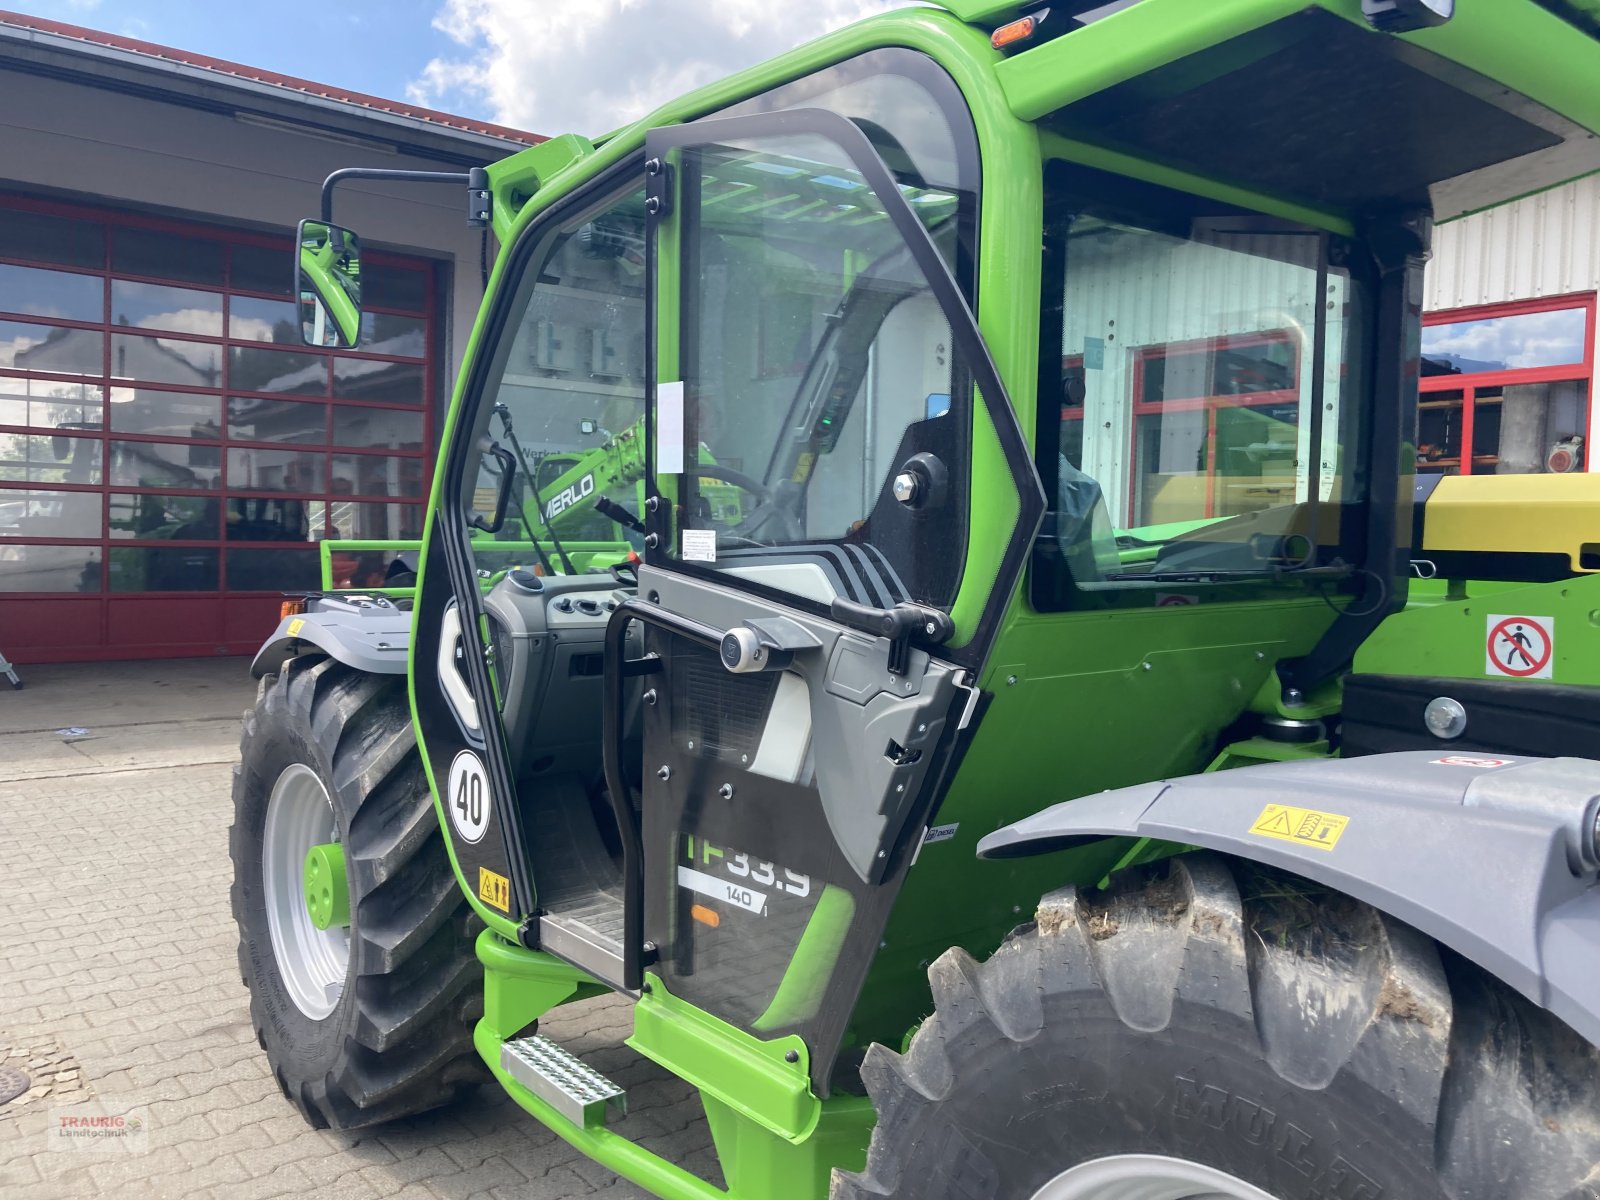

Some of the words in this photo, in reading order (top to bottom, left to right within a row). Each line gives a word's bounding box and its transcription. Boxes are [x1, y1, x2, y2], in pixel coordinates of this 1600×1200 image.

[540, 473, 594, 525] MERLO
[456, 769, 482, 827] 40
[726, 886, 752, 907] 140
